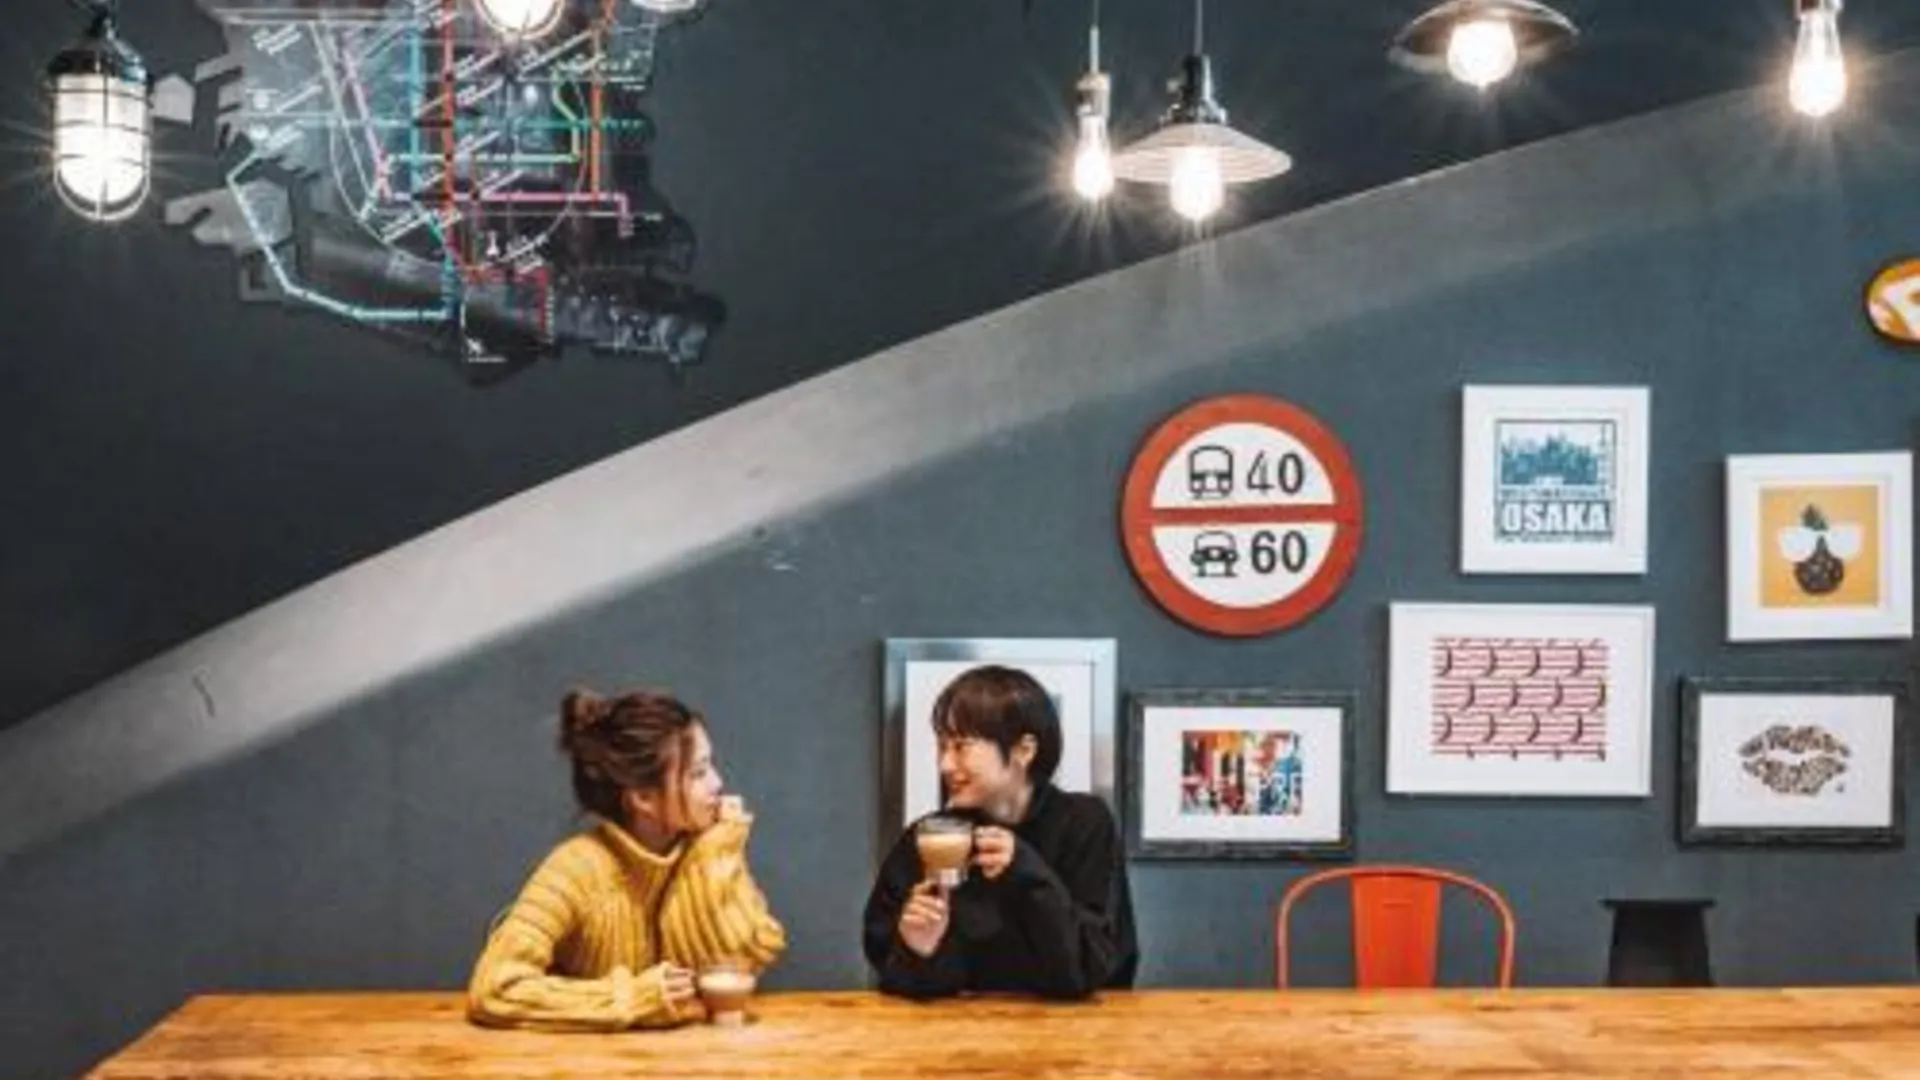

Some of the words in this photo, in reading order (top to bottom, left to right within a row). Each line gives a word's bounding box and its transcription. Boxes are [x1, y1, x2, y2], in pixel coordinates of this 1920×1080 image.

[1246, 450, 1304, 495] 40
[1502, 502, 1608, 532] OSAKA
[1250, 530, 1308, 574] 60
